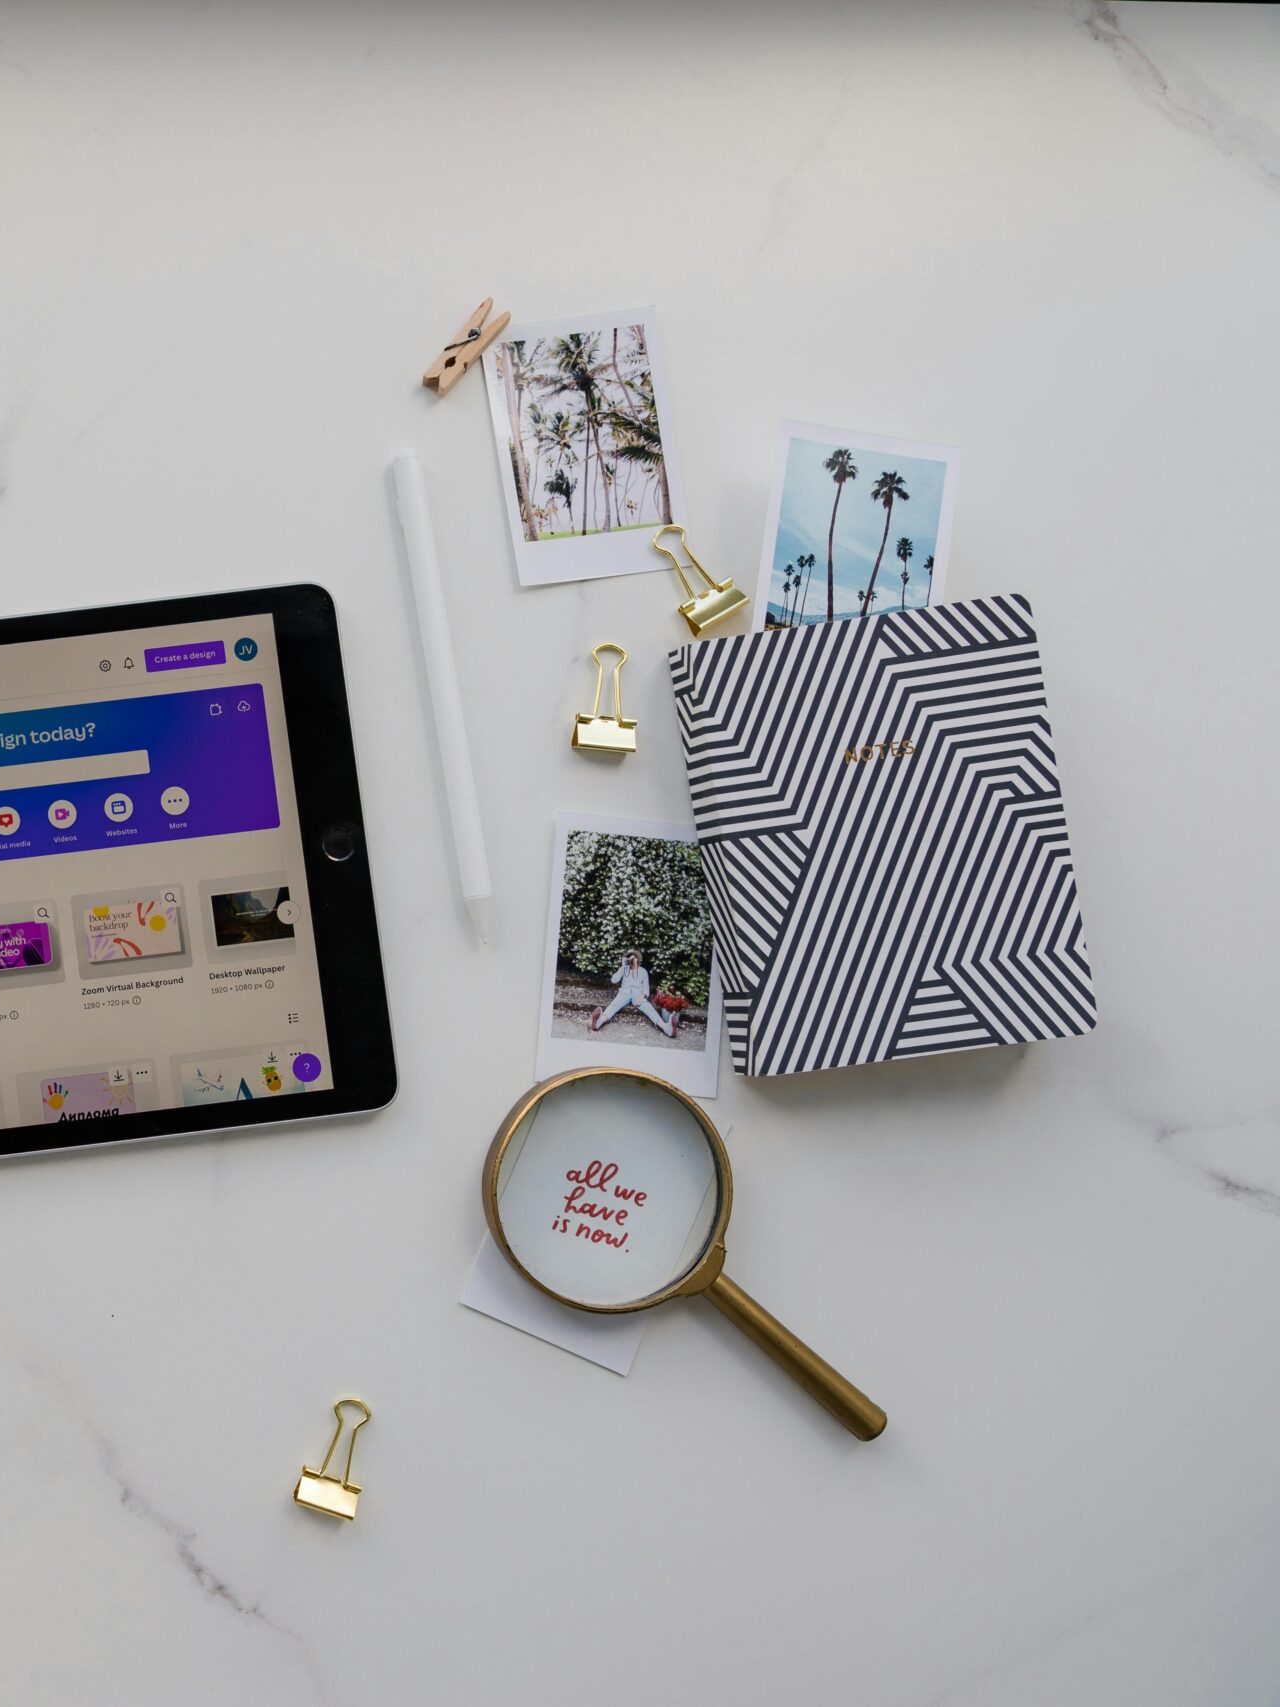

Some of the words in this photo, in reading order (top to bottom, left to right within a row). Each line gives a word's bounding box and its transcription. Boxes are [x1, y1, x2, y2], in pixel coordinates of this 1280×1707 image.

[239, 644, 253, 656] JV
[154, 655, 181, 664] Create
[190, 650, 216, 660] design
[30, 722, 96, 743] today?
[844, 740, 915, 765] NOTES
[169, 821, 187, 830] More
[106, 827, 138, 837] Websites
[9, 839, 31, 849] media
[53, 834, 77, 843] Videos
[112, 911, 132, 921] your
[89, 921, 129, 932] backdrop
[4, 936, 27, 947] with
[209, 969, 243, 981] Desktop
[244, 964, 286, 976] Wallpaper
[81, 986, 105, 996] Zoom
[106, 982, 134, 993] Virtual
[135, 976, 184, 989] Background
[210, 985, 228, 994] 1920
[234, 983, 252, 992] 1080
[254, 982, 263, 990] px
[83, 1001, 100, 1010] 1280
[107, 999, 120, 1008] 720
[121, 999, 130, 1007] px
[0, 1013, 7, 1022] px
[566, 1160, 619, 1192] all
[614, 1185, 647, 1207] we
[564, 1185, 629, 1226] have
[552, 1215, 570, 1233] is
[575, 1223, 629, 1253] now.
